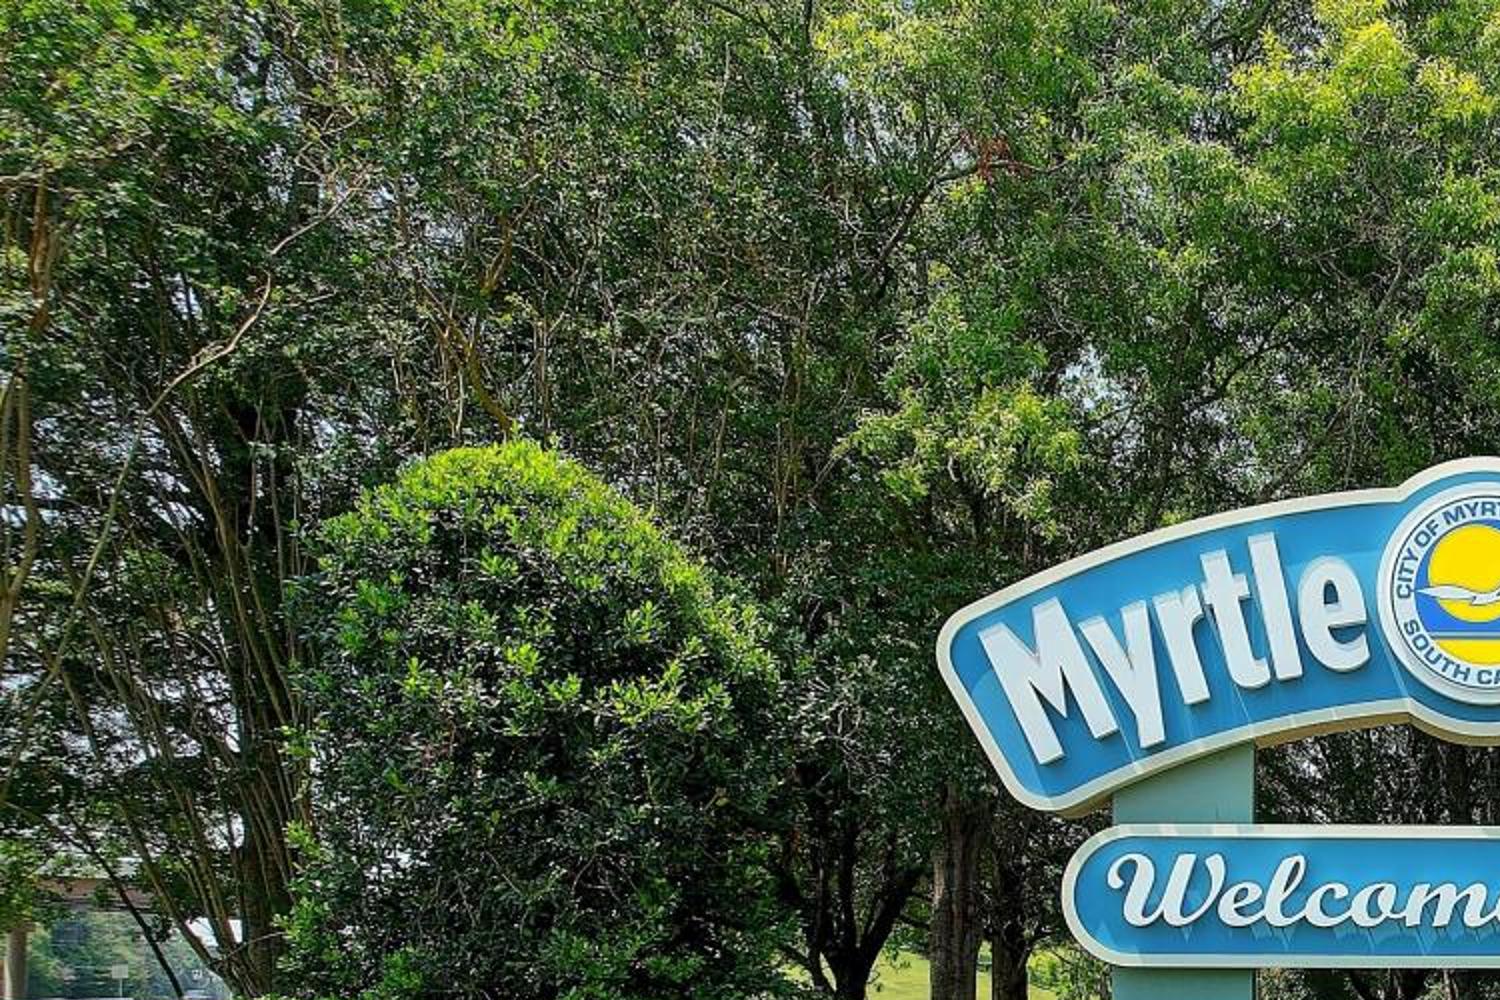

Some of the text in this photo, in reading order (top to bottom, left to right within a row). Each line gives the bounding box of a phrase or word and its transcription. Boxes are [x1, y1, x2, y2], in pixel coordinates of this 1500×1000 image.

[1397, 548, 1419, 599] CITY
[1413, 519, 1442, 546] OF
[979, 532, 1372, 766] Myrtle
[1403, 619, 1471, 682] SOUTH
